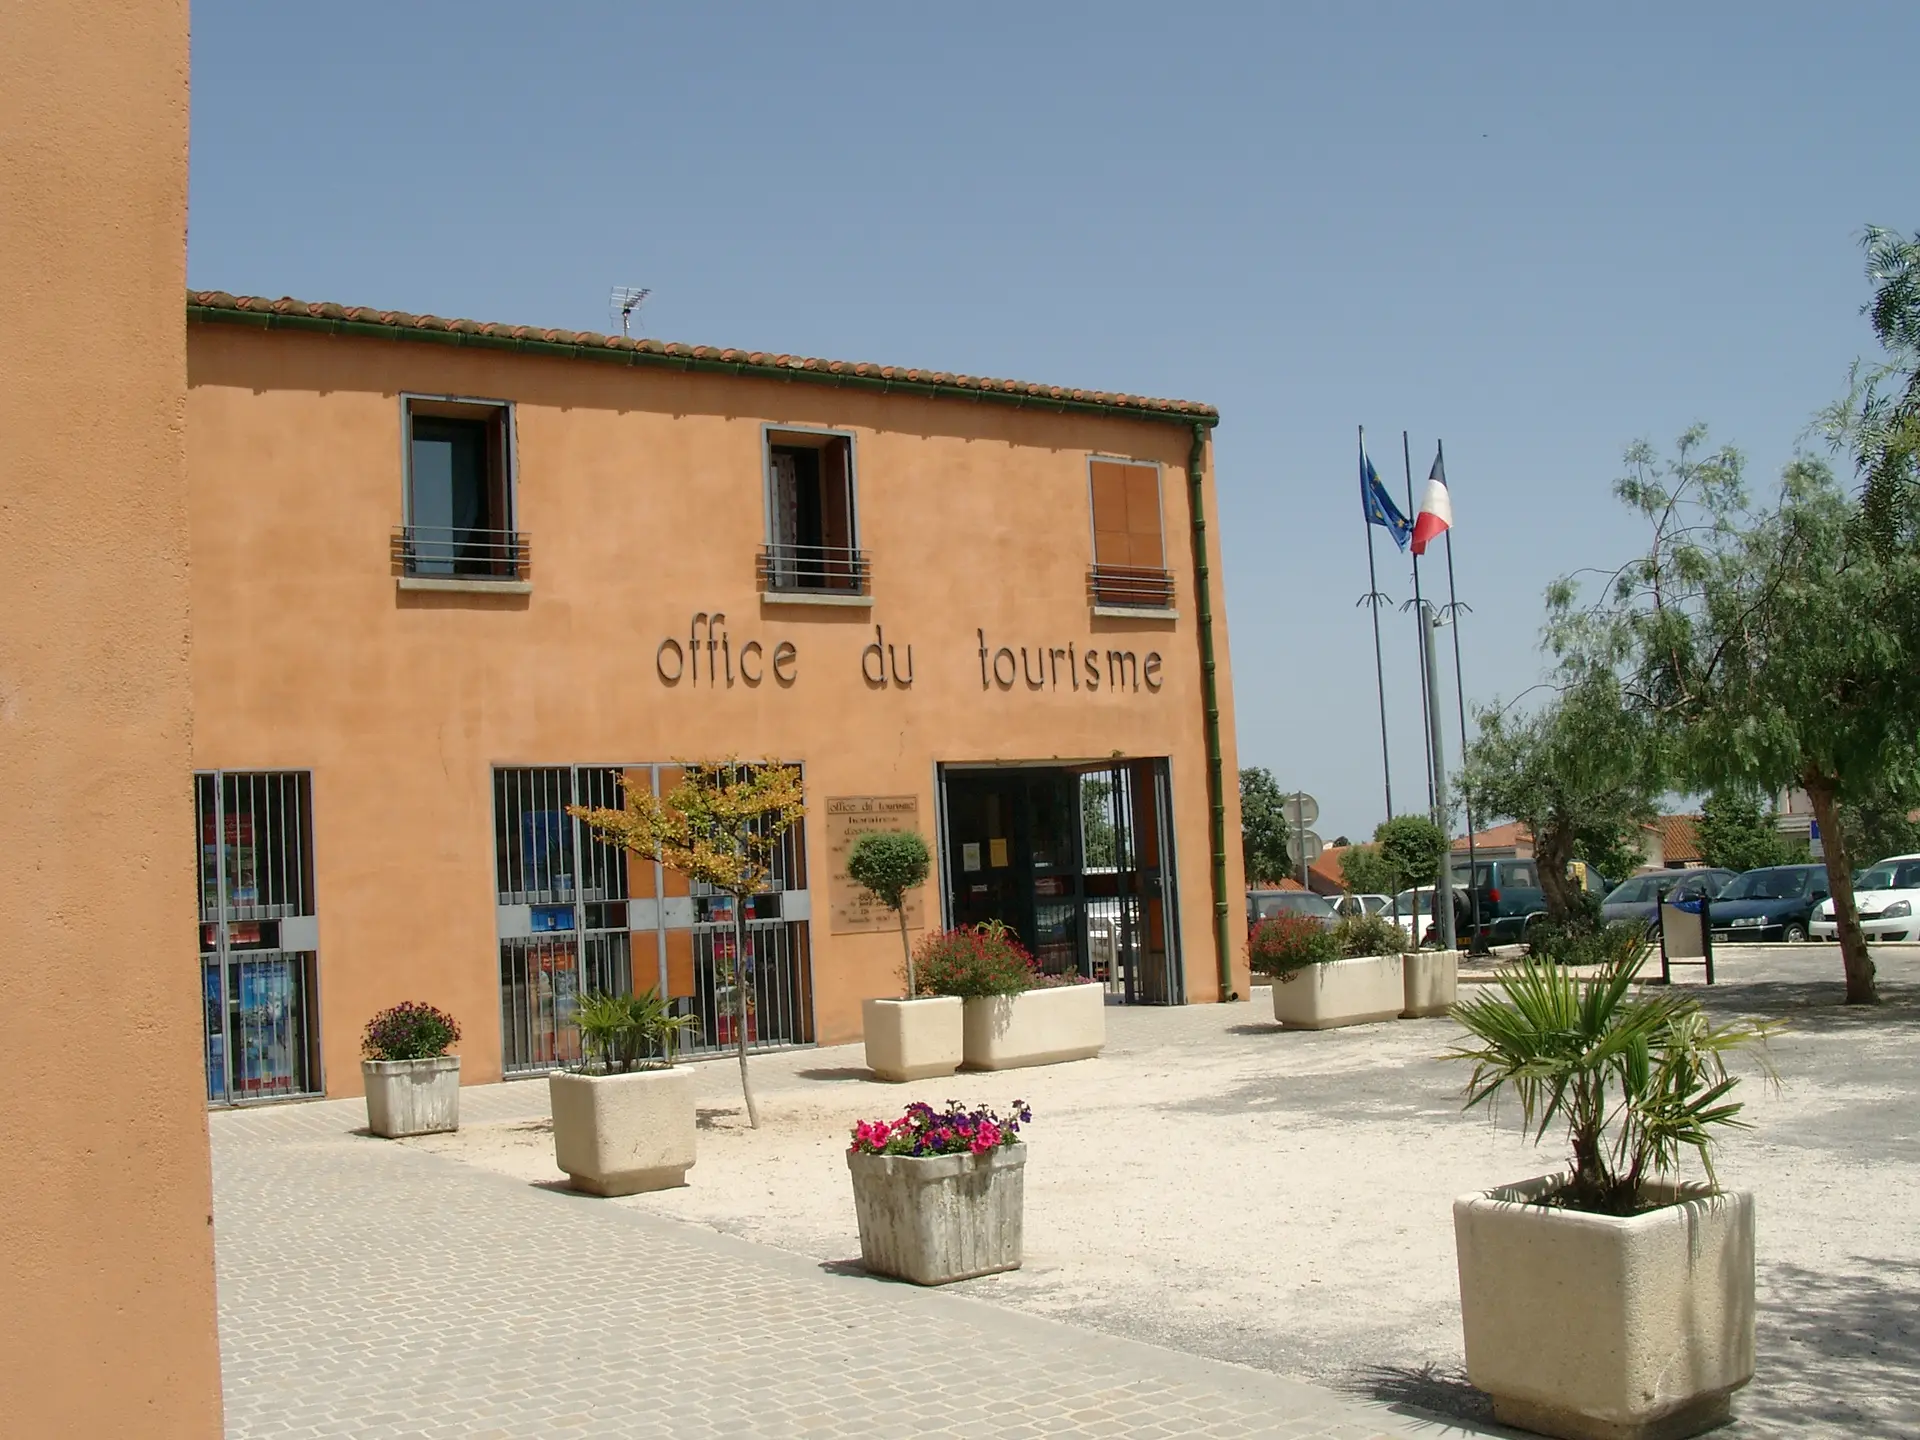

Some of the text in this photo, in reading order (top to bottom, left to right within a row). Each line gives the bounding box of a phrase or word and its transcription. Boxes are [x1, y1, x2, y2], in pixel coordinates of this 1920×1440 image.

[656, 612, 1164, 689] office du tourisme
[829, 801, 856, 813] office
